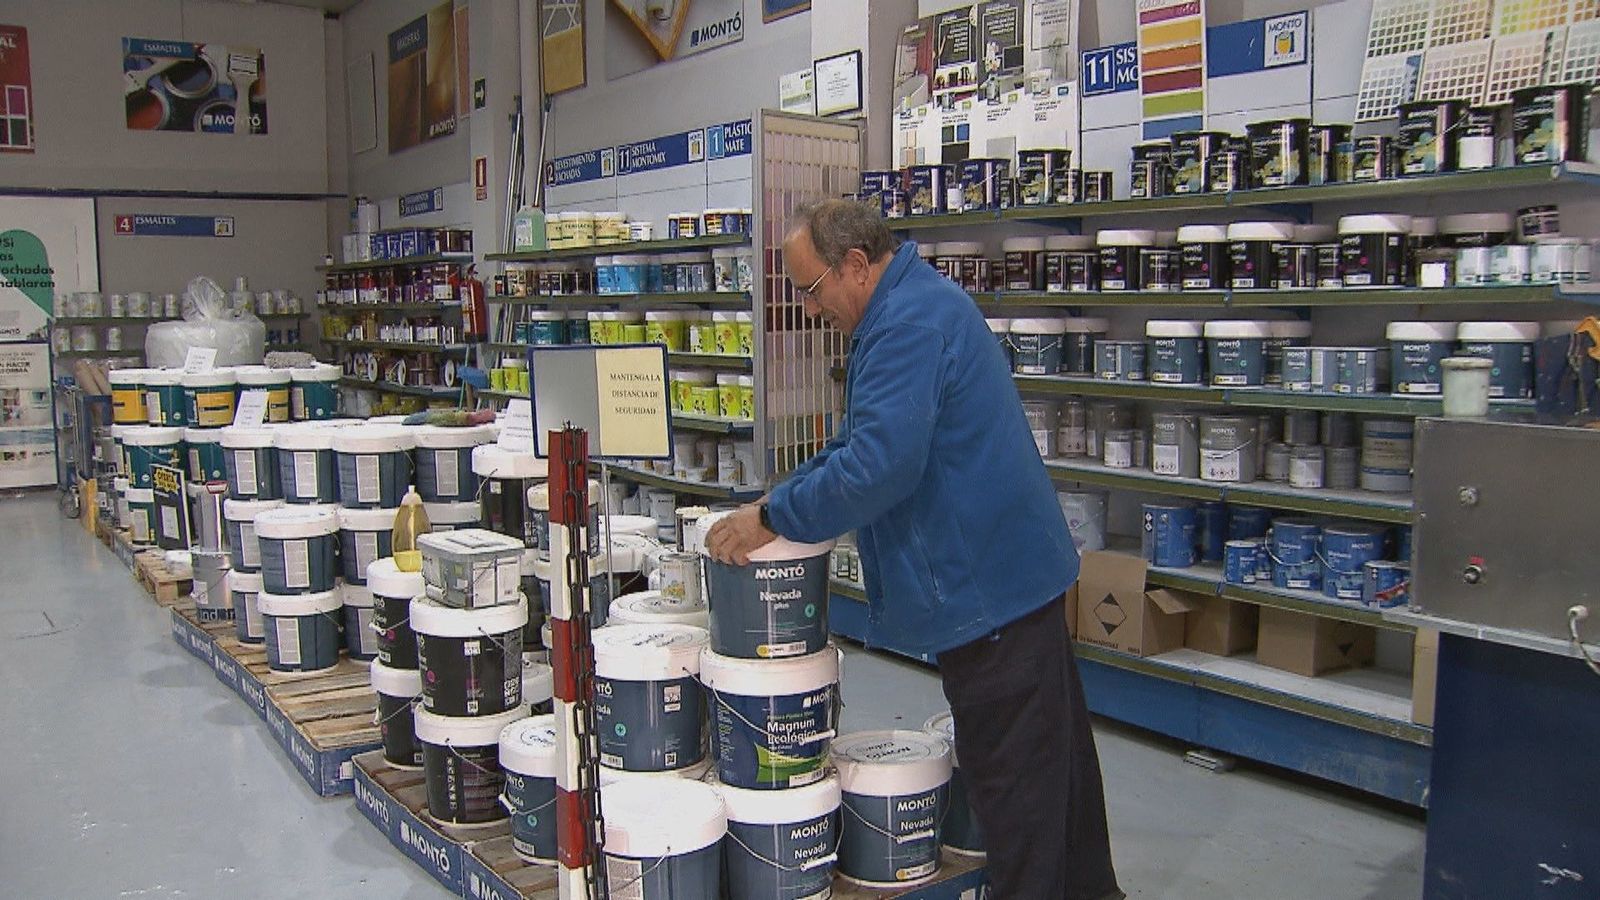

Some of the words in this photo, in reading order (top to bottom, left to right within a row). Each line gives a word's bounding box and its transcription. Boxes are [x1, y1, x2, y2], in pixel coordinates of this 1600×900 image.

[699, 10, 742, 43] MONTÓ
[143, 43, 182, 53] ESMALTES
[1086, 56, 1109, 86] 11
[631, 142, 657, 157] SISTEMA
[715, 136, 721, 154] 1
[724, 139, 745, 152] MATE
[619, 149, 630, 170] 11
[631, 152, 666, 170] MONTOMIX
[549, 165, 557, 182] 2
[120, 217, 130, 232] 4
[135, 216, 177, 226] ESMALTES
[610, 373, 650, 382] MANTENGA
[611, 390, 650, 398] DISTANCIA
[614, 406, 656, 415] SEGURIDAD
[755, 564, 805, 580] MONTÓ
[759, 588, 802, 601] Nevada
[767, 717, 815, 739] Magnum
[767, 729, 817, 746] Ecológico
[361, 783, 389, 823] MONTÓ
[897, 794, 936, 812] MONTÓ
[791, 817, 829, 840] MONTÓ
[900, 816, 934, 832] Nevada
[410, 829, 451, 872] MONTÓ
[794, 842, 827, 860] Nevada
[481, 880, 504, 900] MO
